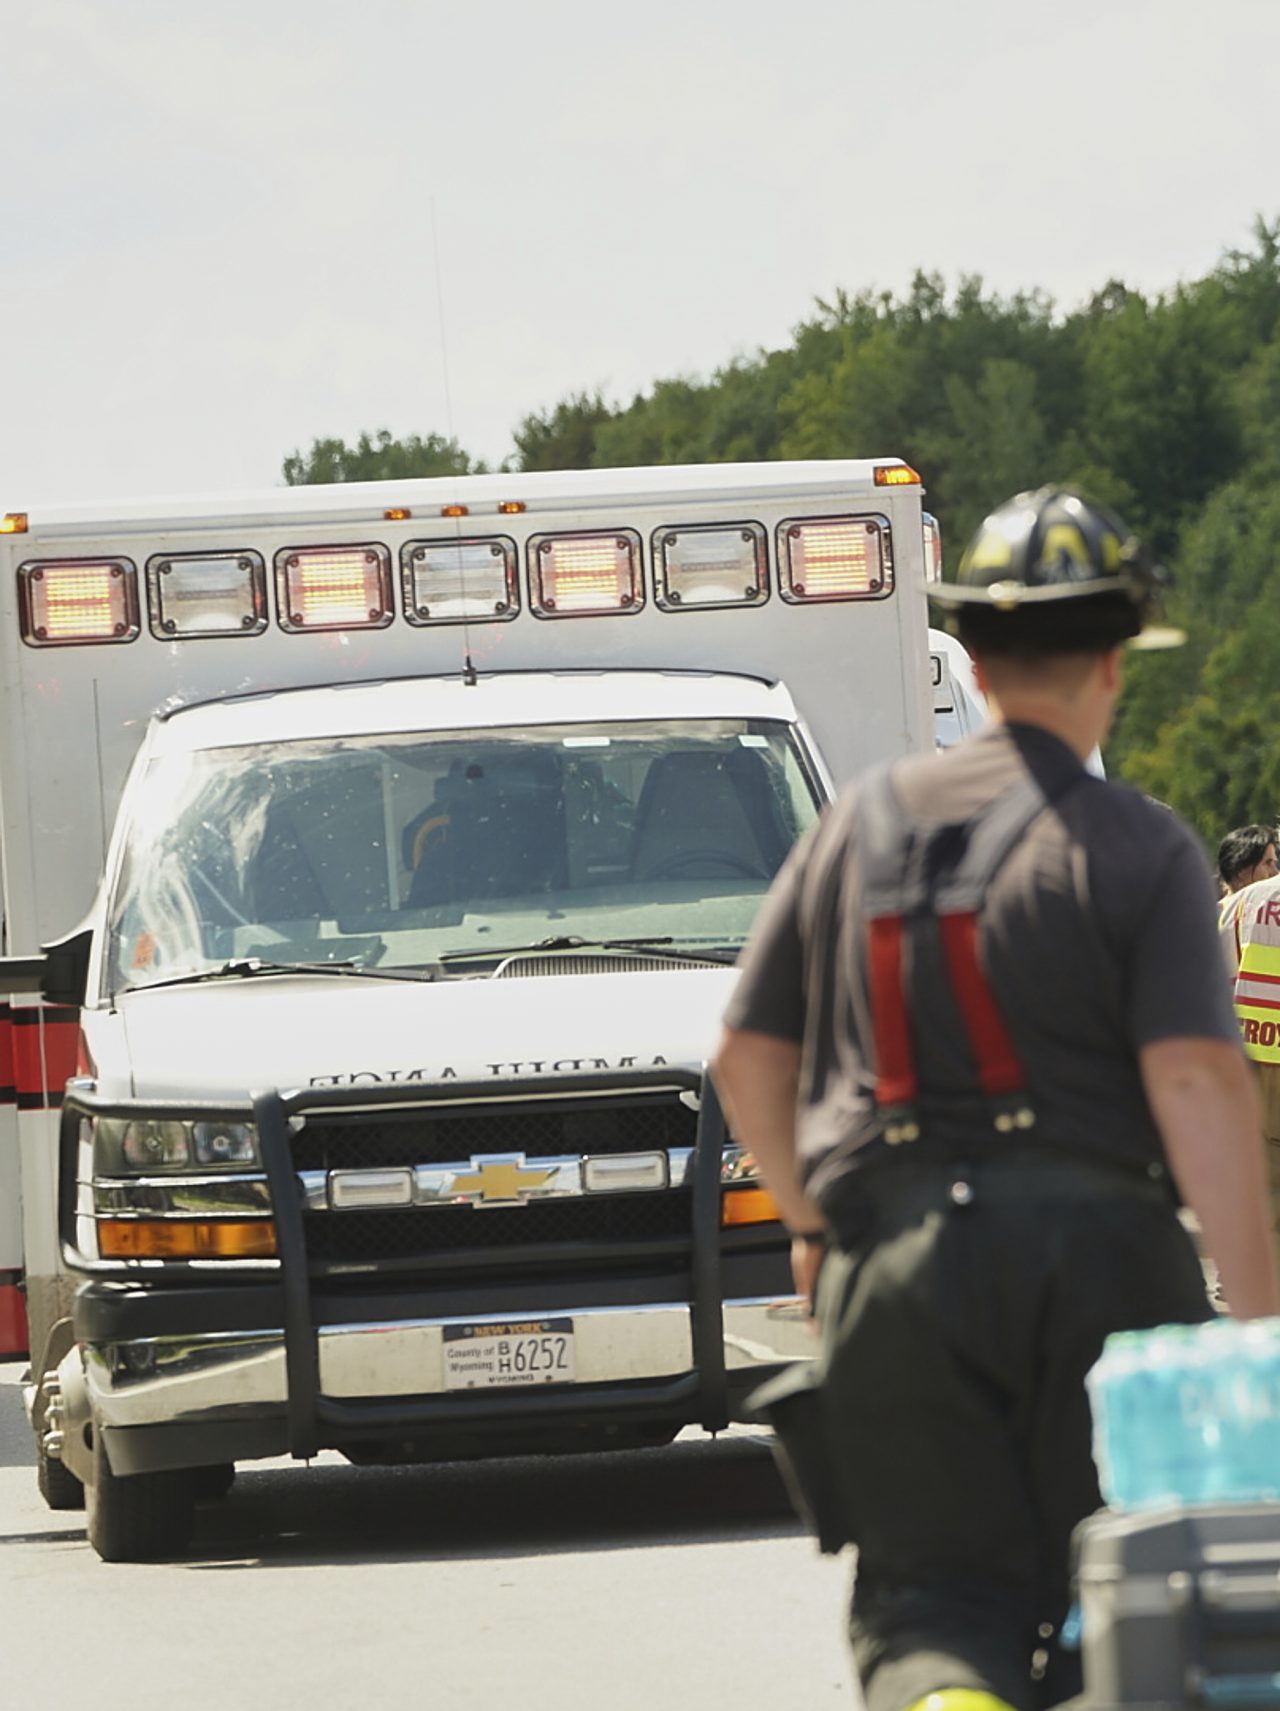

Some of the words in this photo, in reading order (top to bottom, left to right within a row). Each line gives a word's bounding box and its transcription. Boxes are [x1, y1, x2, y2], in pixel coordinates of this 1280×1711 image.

[448, 1347, 480, 1359] County
[484, 1346, 495, 1356] of
[514, 1337, 568, 1372] 6252
[449, 1361, 493, 1373] Wyoming
